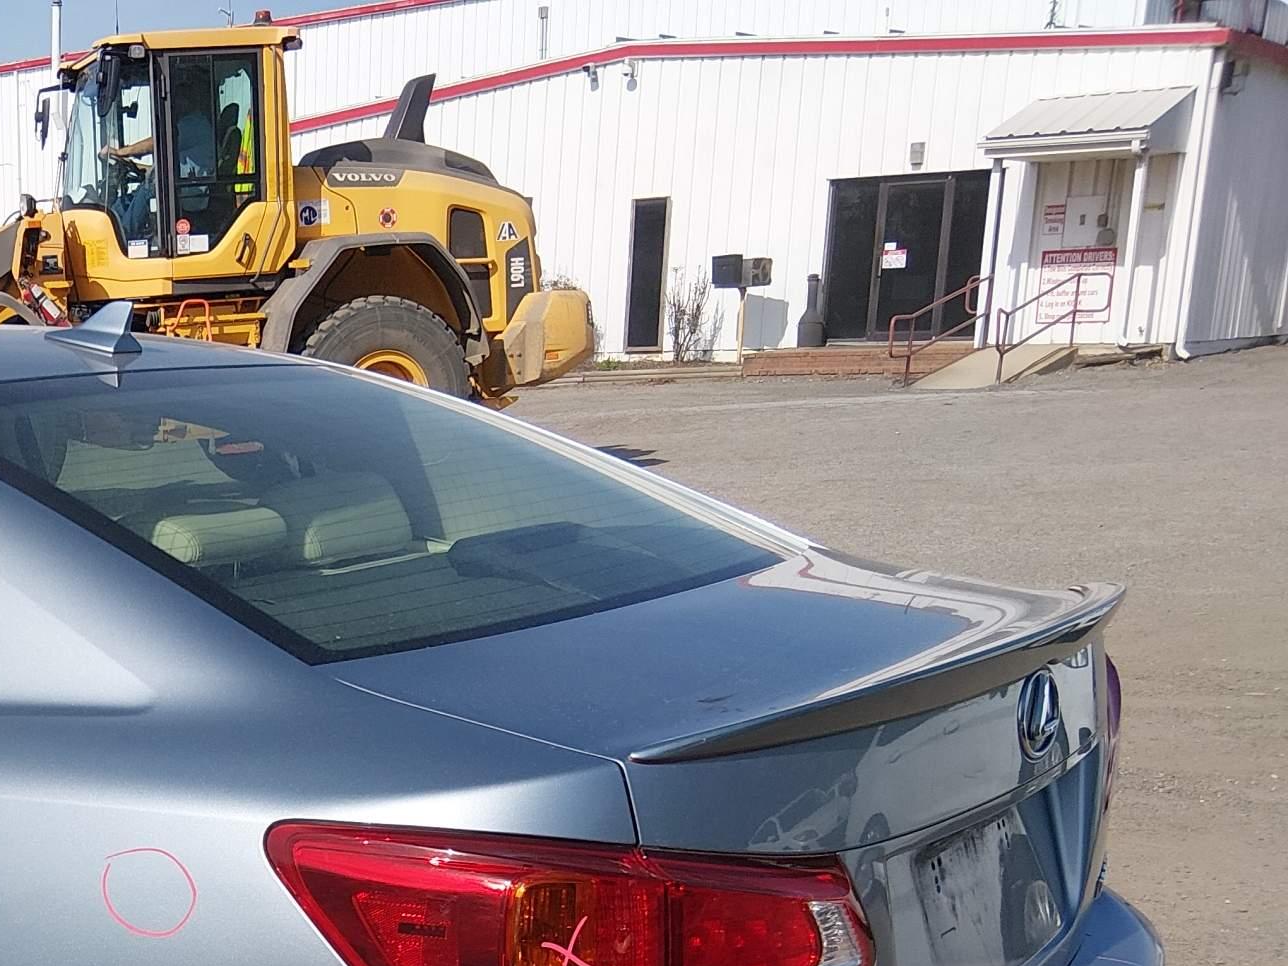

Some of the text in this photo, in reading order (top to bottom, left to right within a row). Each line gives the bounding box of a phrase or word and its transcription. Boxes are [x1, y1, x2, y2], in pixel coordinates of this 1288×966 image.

[331, 172, 396, 182] VOLVO
[1044, 252, 1082, 264] ATTENTION
[510, 257, 525, 288] L90H
